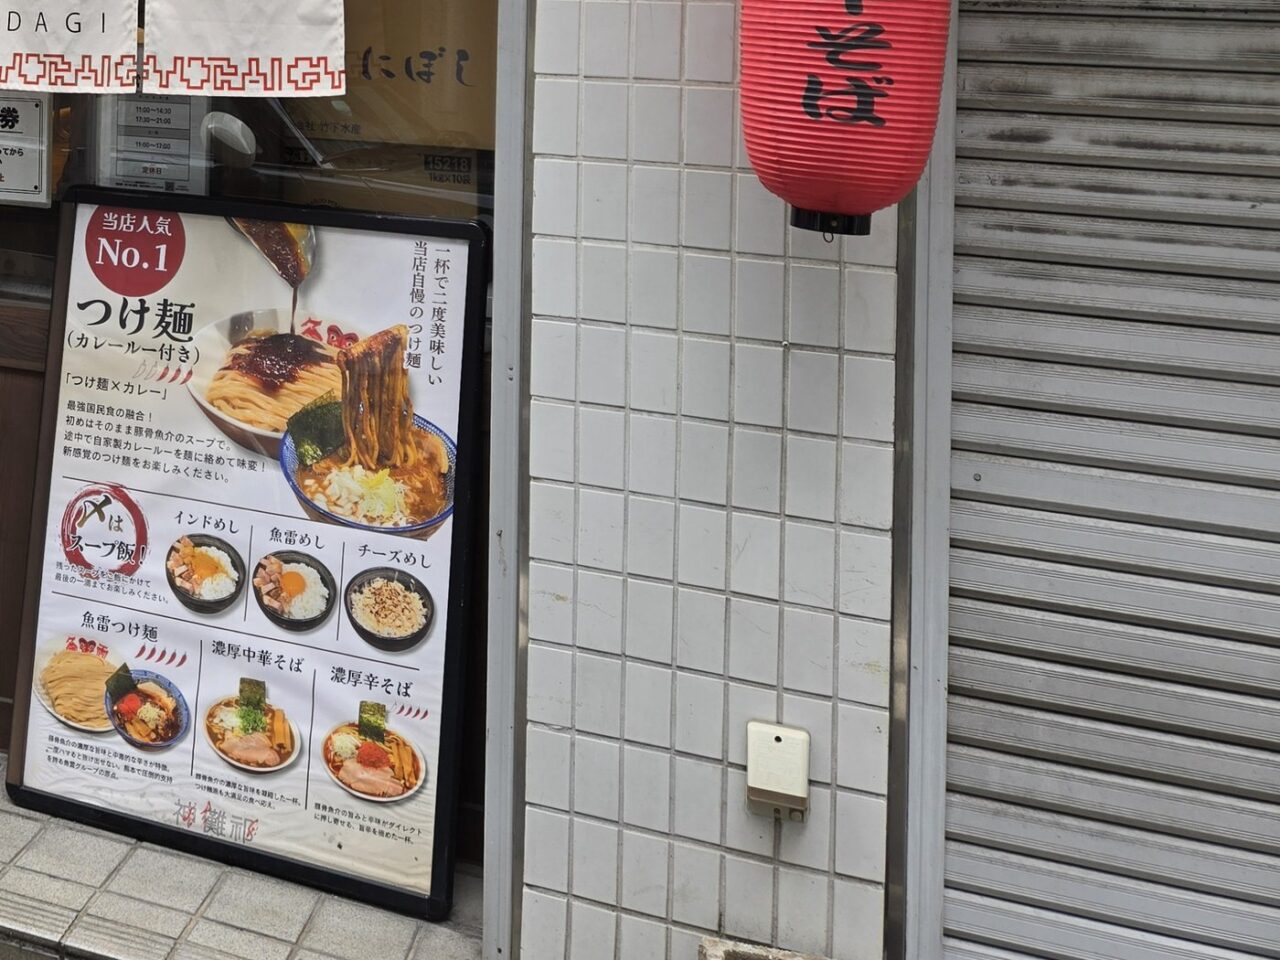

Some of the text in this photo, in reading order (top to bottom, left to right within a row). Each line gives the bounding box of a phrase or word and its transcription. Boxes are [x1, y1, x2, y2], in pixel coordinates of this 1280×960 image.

[102, 212, 172, 236] 当店人気
[95, 237, 168, 272] No.1
[76, 296, 196, 343] つけ麺
[405, 240, 428, 369] 当店自慢のつけ麺
[428, 248, 451, 385] 一杯で二度美味しい
[174, 510, 240, 535] インドめし
[269, 527, 326, 550] 魚雷めし
[358, 543, 432, 569] チーズめし
[81, 611, 159, 643] 魚雷つけ麺
[212, 640, 305, 674] 濃厚中華そば
[331, 666, 414, 698] 濃厚辛そば
